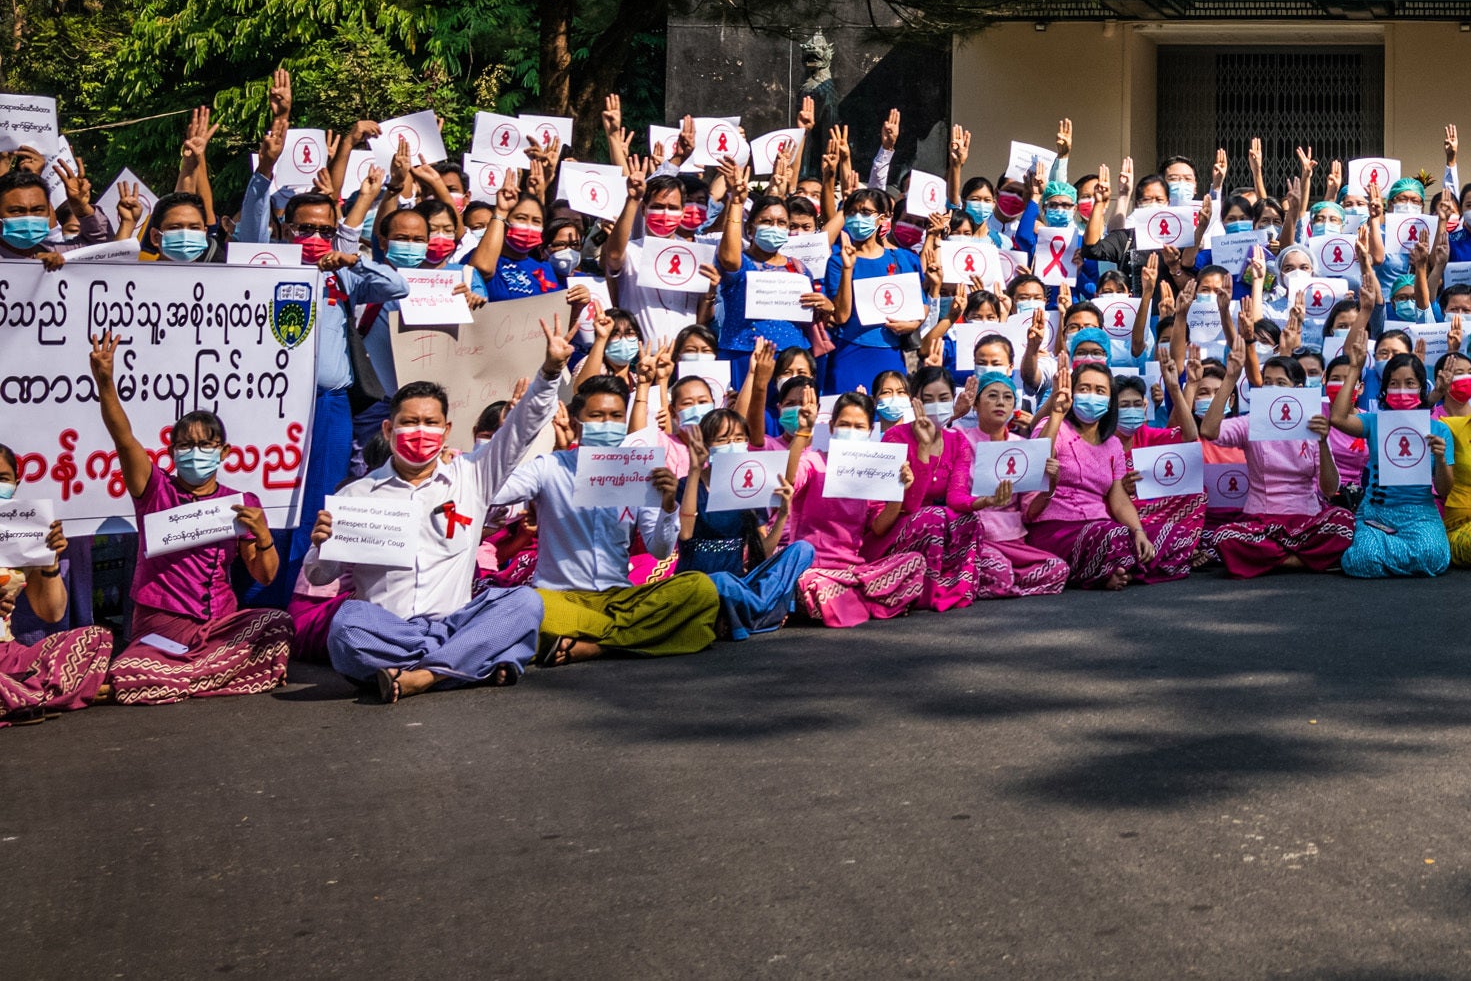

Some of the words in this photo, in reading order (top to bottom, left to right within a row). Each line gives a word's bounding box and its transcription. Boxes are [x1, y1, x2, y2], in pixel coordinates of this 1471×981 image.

[0, 280, 68, 345] ်သည်
[205, 505, 221, 517] စနစ်
[384, 509, 410, 518] Leaders
[337, 520, 368, 529] #Respect
[369, 522, 381, 530] Our
[383, 523, 402, 532] Votes
[334, 534, 359, 544] #Reject
[361, 537, 386, 547] Military
[387, 539, 405, 548] Coup
